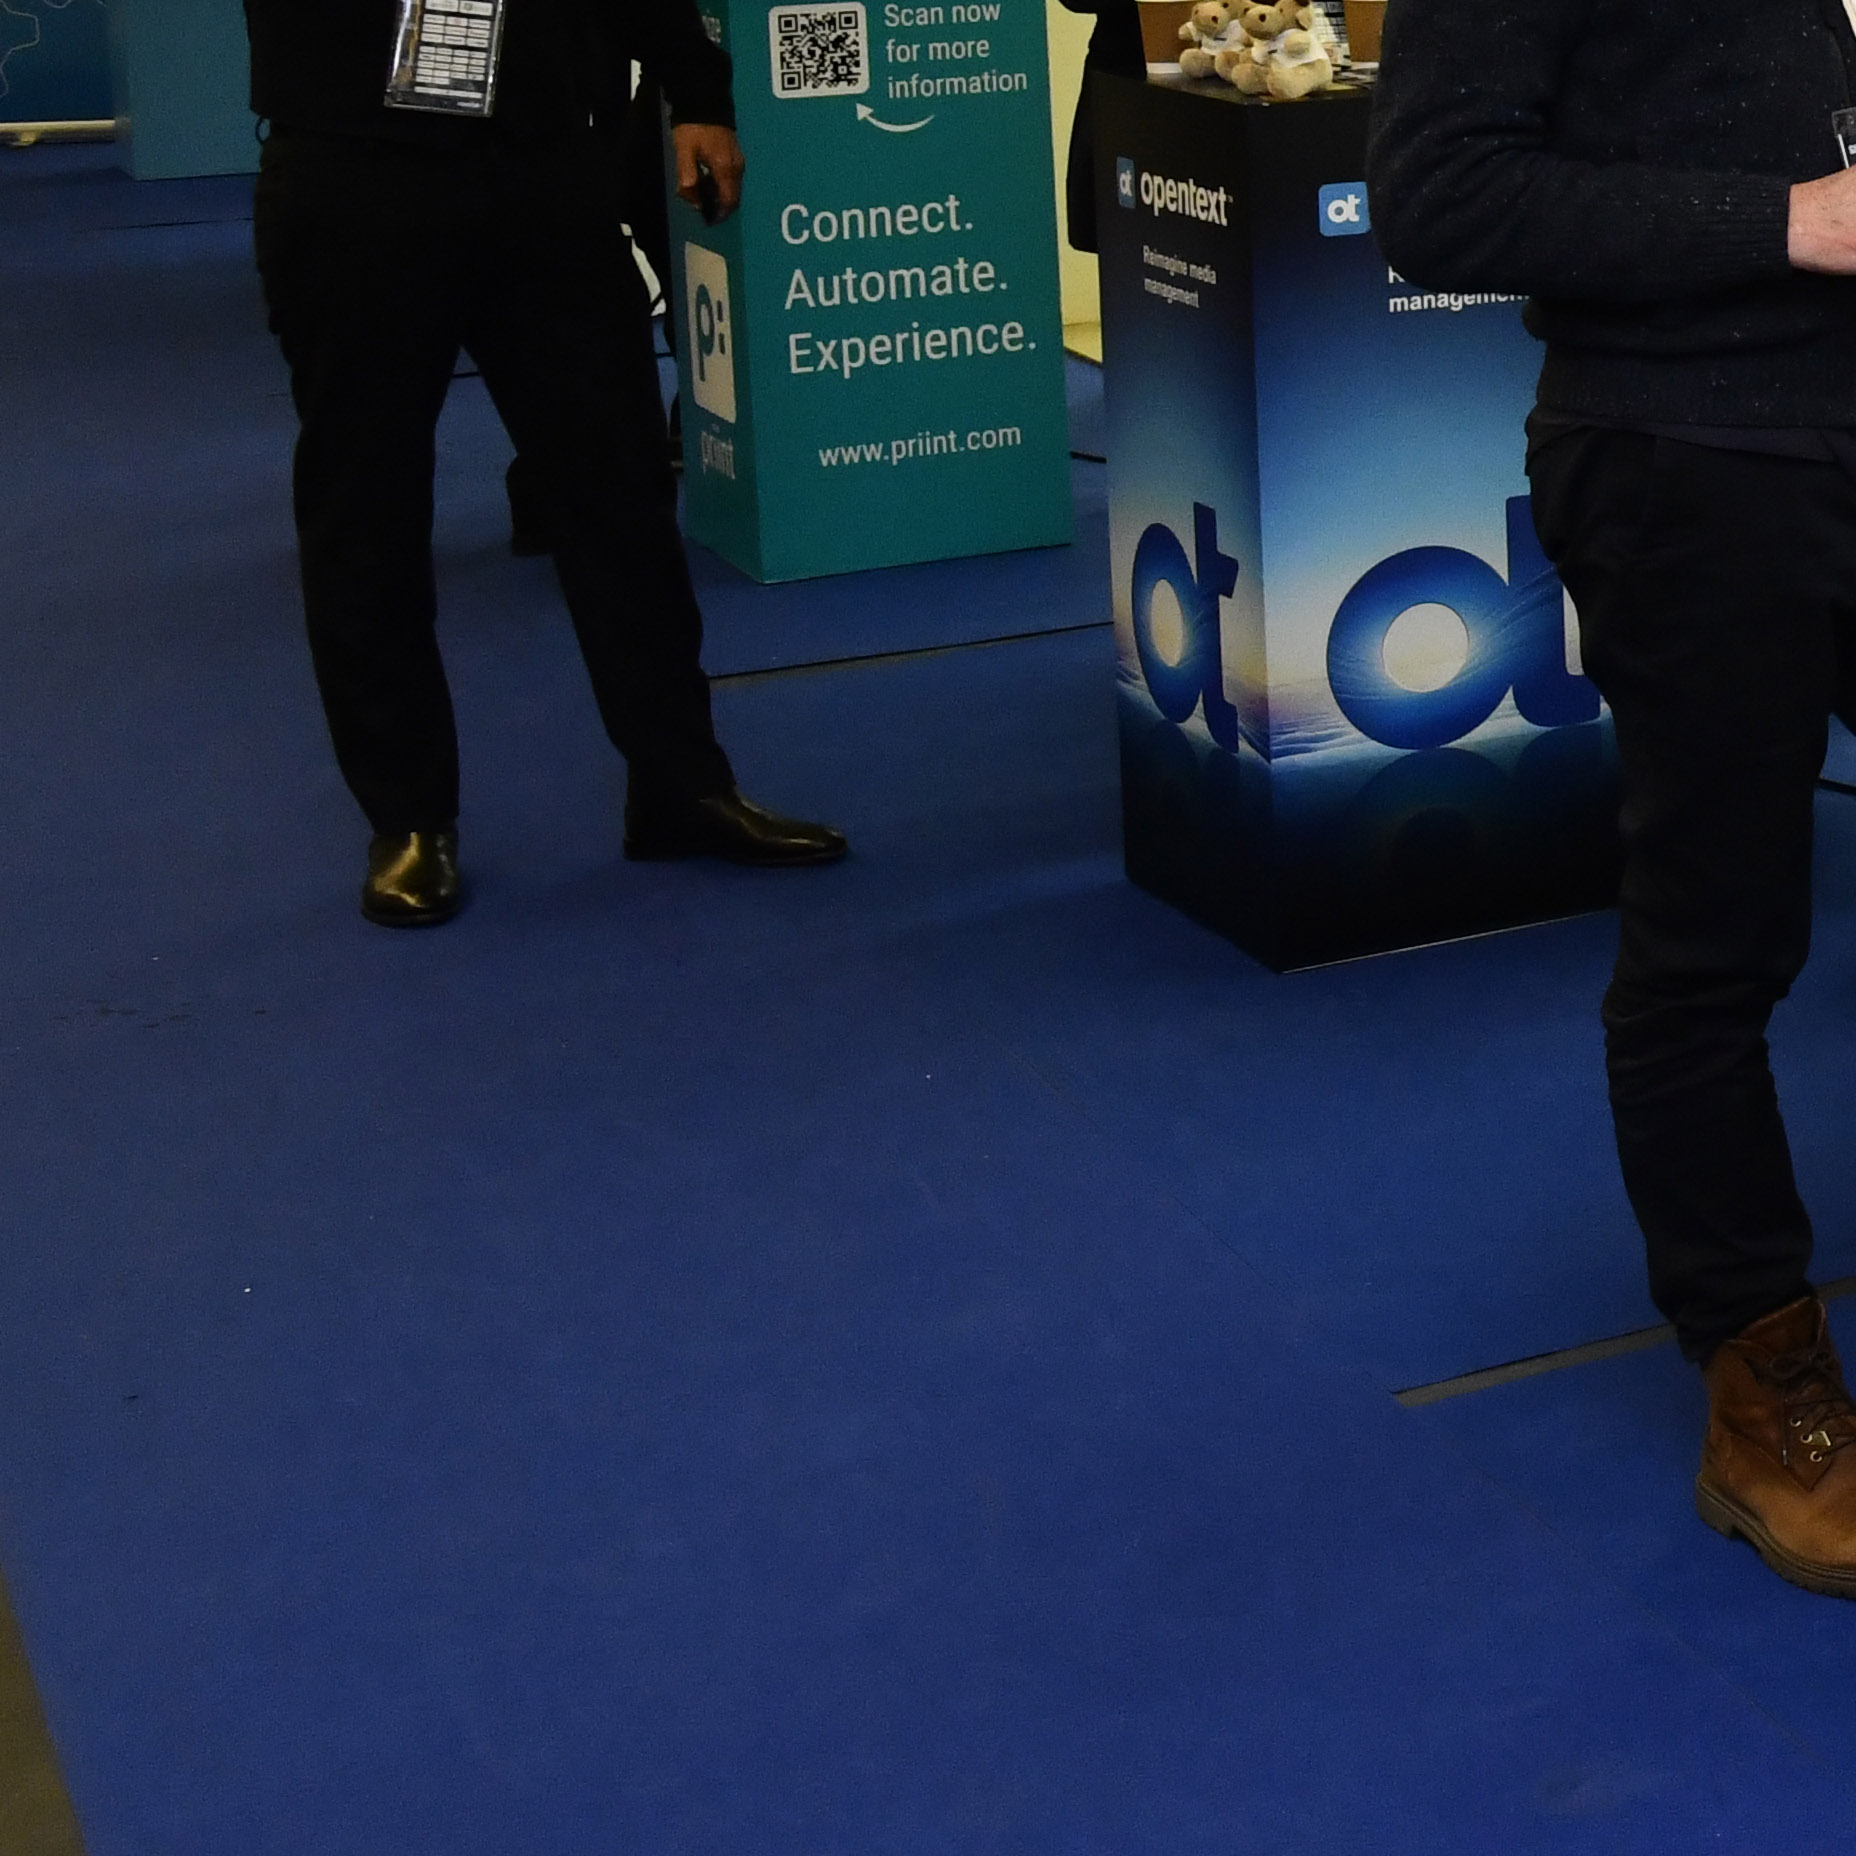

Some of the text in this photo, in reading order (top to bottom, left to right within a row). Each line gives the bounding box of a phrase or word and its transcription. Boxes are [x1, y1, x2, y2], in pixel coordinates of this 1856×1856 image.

[884, 2, 1001, 29] Scan now
[886, 38, 991, 64] for more
[887, 69, 1028, 100] information
[780, 194, 974, 245] Connect.
[1140, 171, 1229, 227] opentext
[784, 257, 1009, 311] Automate.
[1143, 244, 1217, 285] Reimagine media
[1143, 277, 1200, 309] management
[788, 319, 1037, 379] Experience.
[818, 424, 1022, 467] www.priint.com
